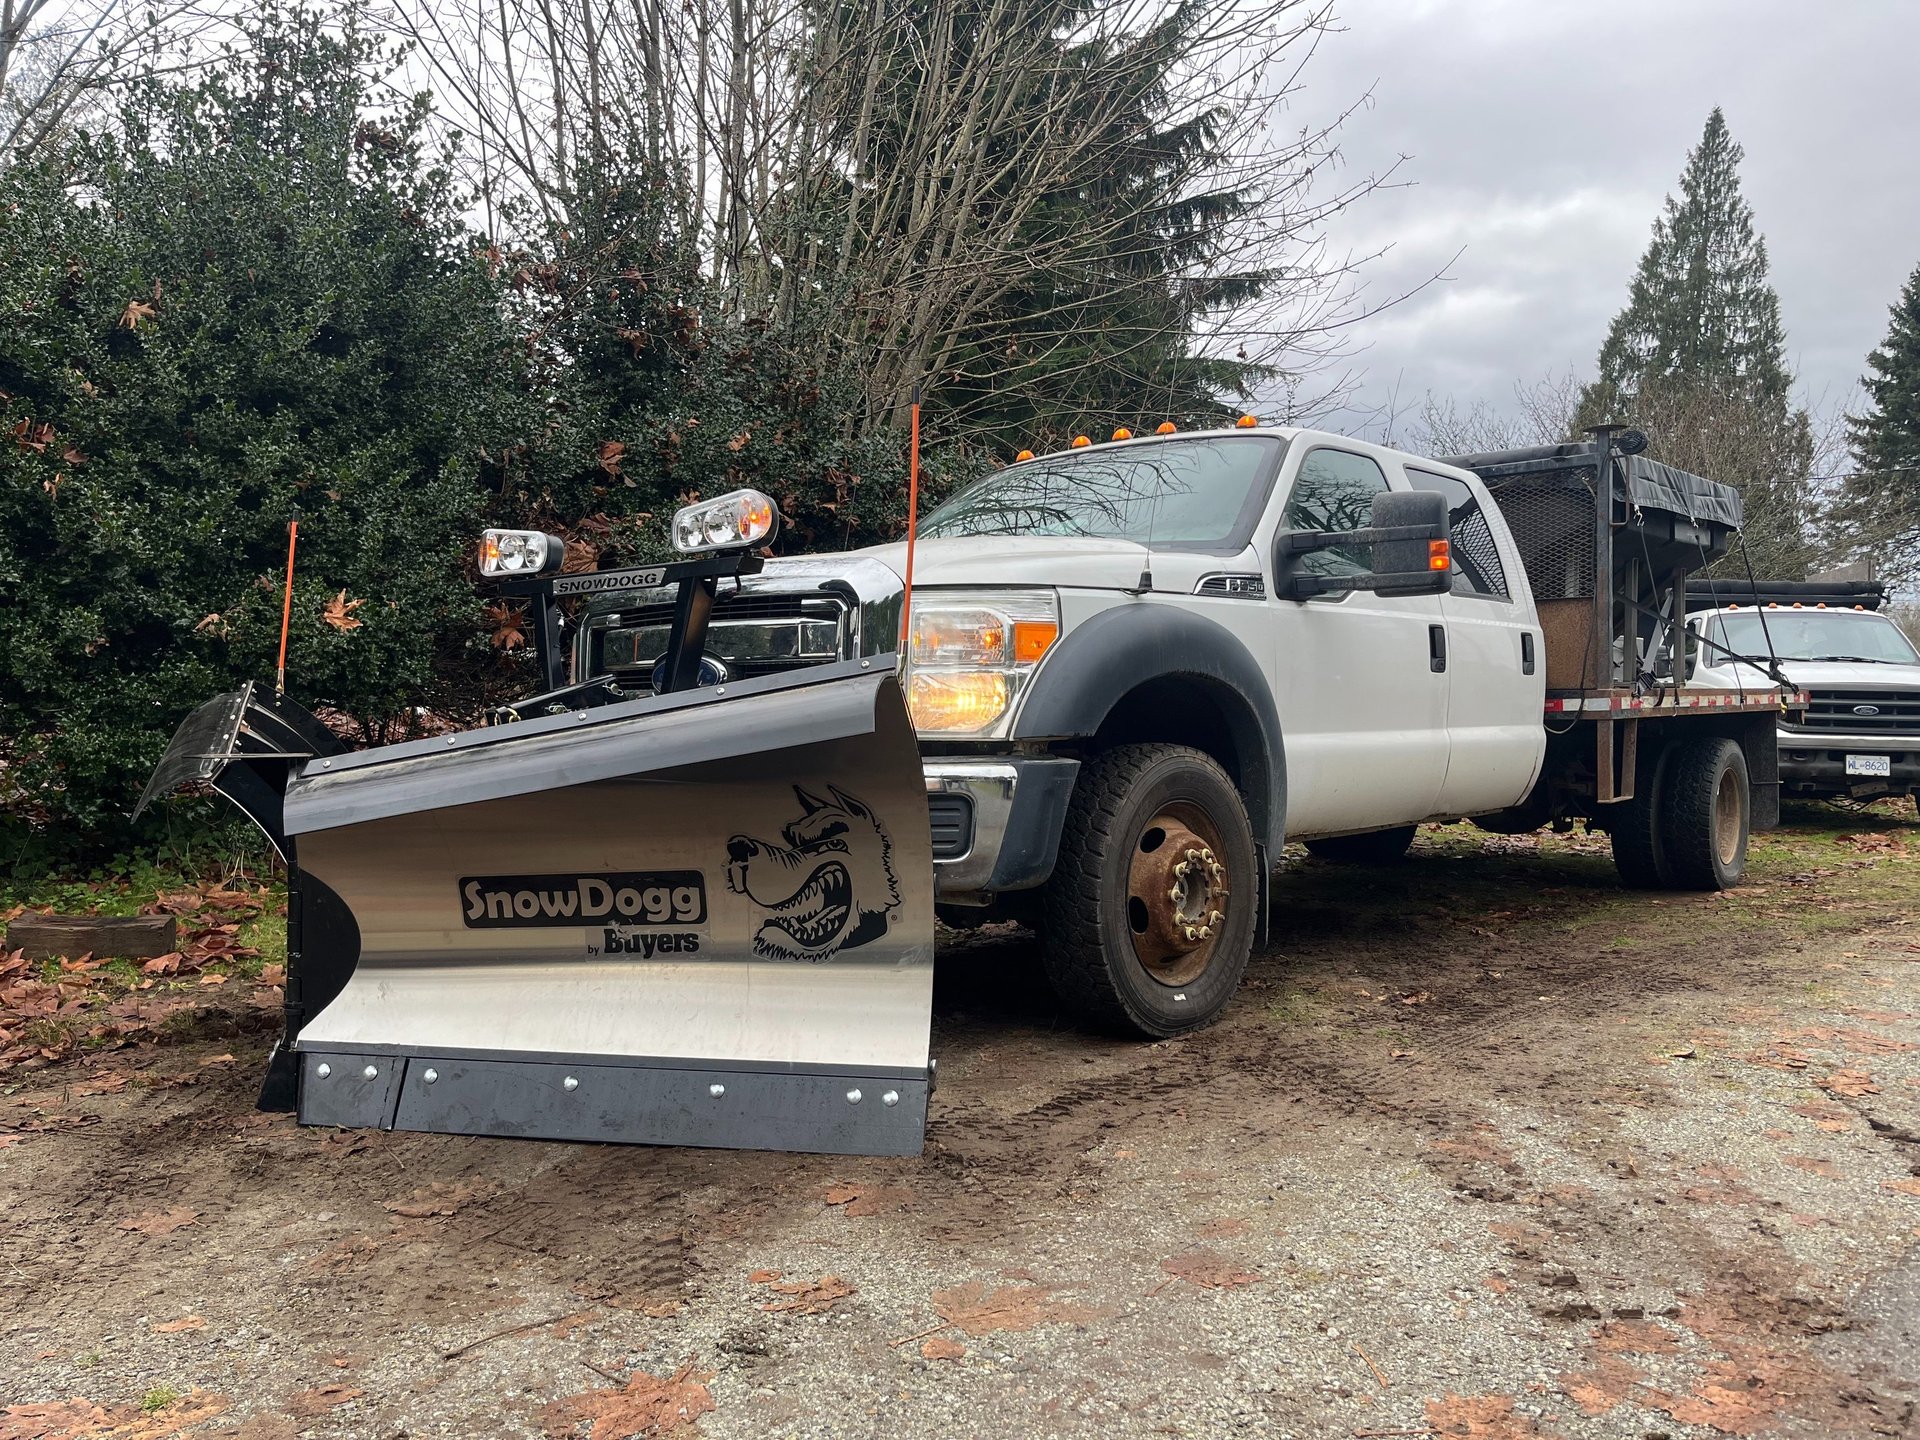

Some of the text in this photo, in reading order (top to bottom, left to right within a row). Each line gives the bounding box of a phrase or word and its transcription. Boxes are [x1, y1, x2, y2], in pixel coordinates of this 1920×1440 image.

[559, 574, 657, 592] SNOWDOGG
[1848, 760, 1888, 771] WL-8620
[464, 878, 701, 922] SnowDogg
[588, 928, 699, 959] by Buyers
